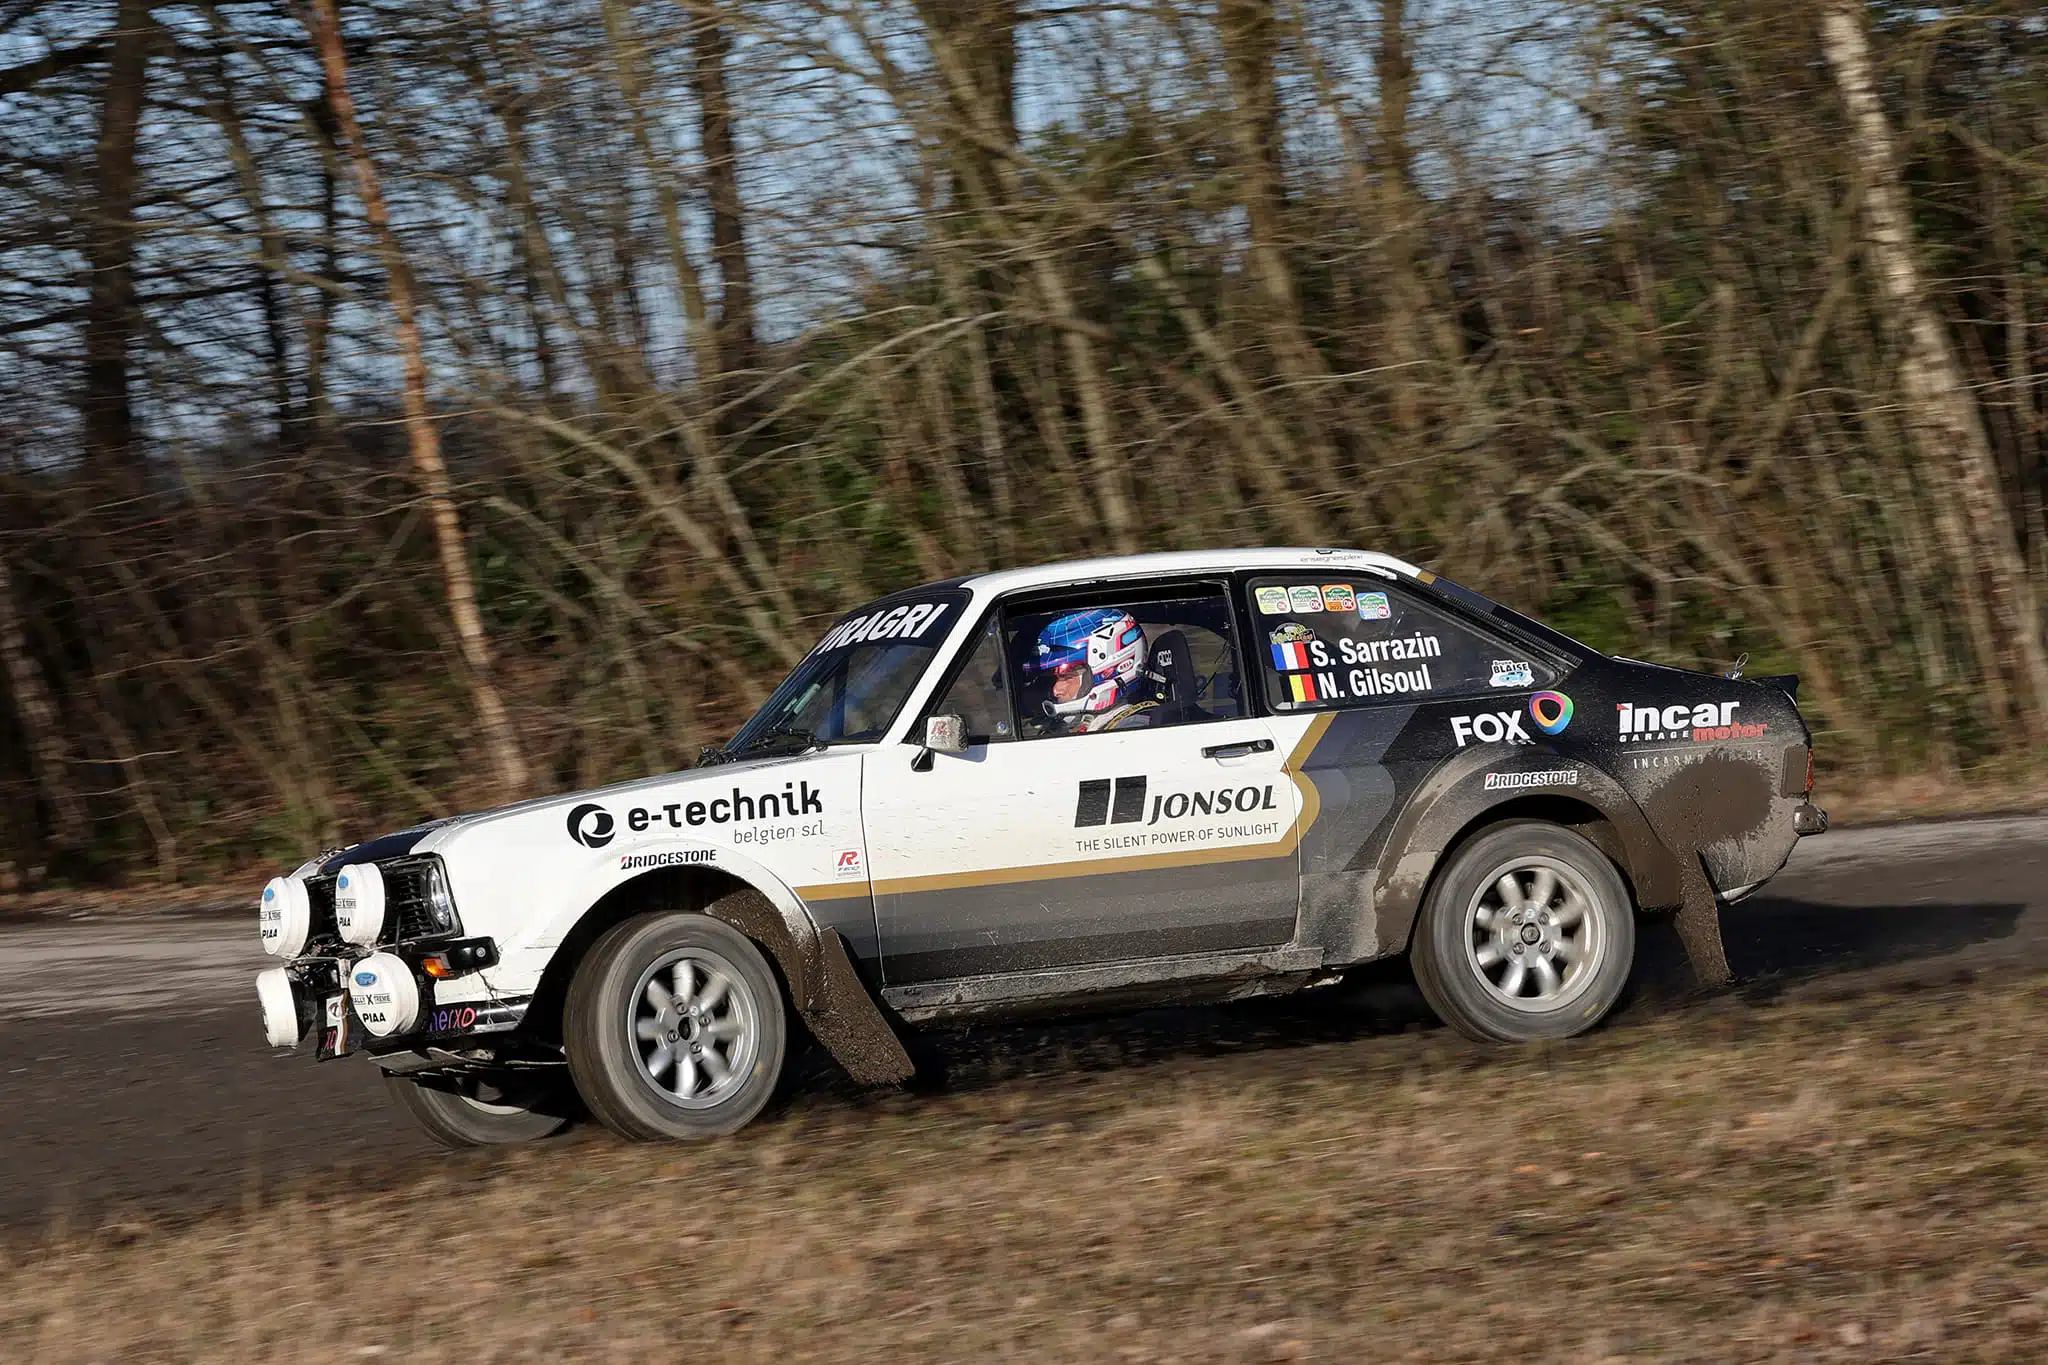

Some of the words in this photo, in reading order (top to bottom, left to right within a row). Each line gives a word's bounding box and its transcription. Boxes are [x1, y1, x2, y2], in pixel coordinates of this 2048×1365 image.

[1310, 641, 1336, 667] S.
[1339, 632, 1442, 665] Sarrazin
[1493, 663, 1529, 673] BLAISE
[1318, 672, 1345, 699] N.
[1350, 664, 1432, 697] Gilsoul
[1450, 710, 1531, 746] FOX
[1619, 731, 1689, 742] GARAGE
[1692, 722, 1768, 742] motor
[1486, 771, 1576, 789] BRIDGESTONE
[628, 781, 822, 832] e-technik
[1147, 785, 1277, 826] JONSOL
[734, 826, 795, 844] belgien
[801, 820, 825, 837] srl
[1076, 839, 1100, 852] THE
[1104, 834, 1147, 850] SILENT
[1151, 831, 1195, 845] POWER
[1198, 828, 1214, 840] OF
[1217, 822, 1279, 839] SUNLIGHT
[621, 850, 717, 870] BRIDGESTONE
[339, 916, 351, 927] PIAA
[262, 929, 278, 938] PIAA
[362, 1012, 386, 1023] PIAA
